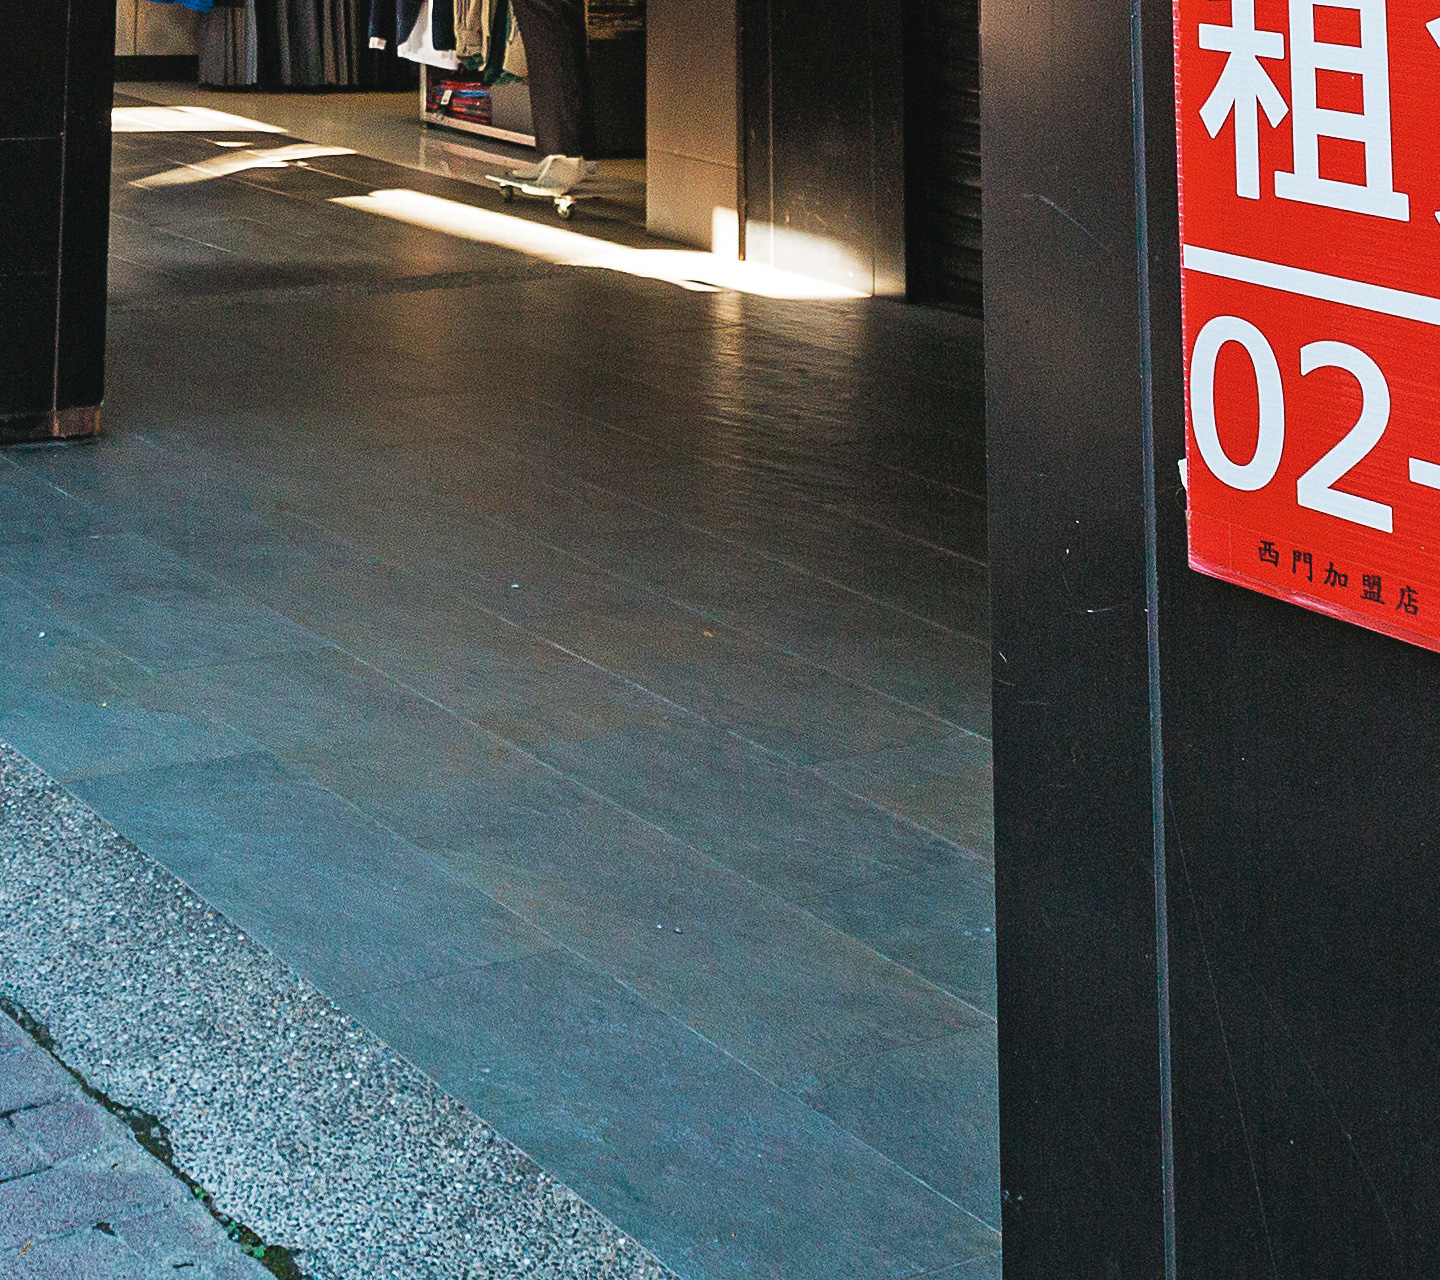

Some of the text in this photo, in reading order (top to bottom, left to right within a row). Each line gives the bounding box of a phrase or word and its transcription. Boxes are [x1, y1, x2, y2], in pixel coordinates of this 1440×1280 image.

[1256, 539, 1421, 616] 西門加盟店
